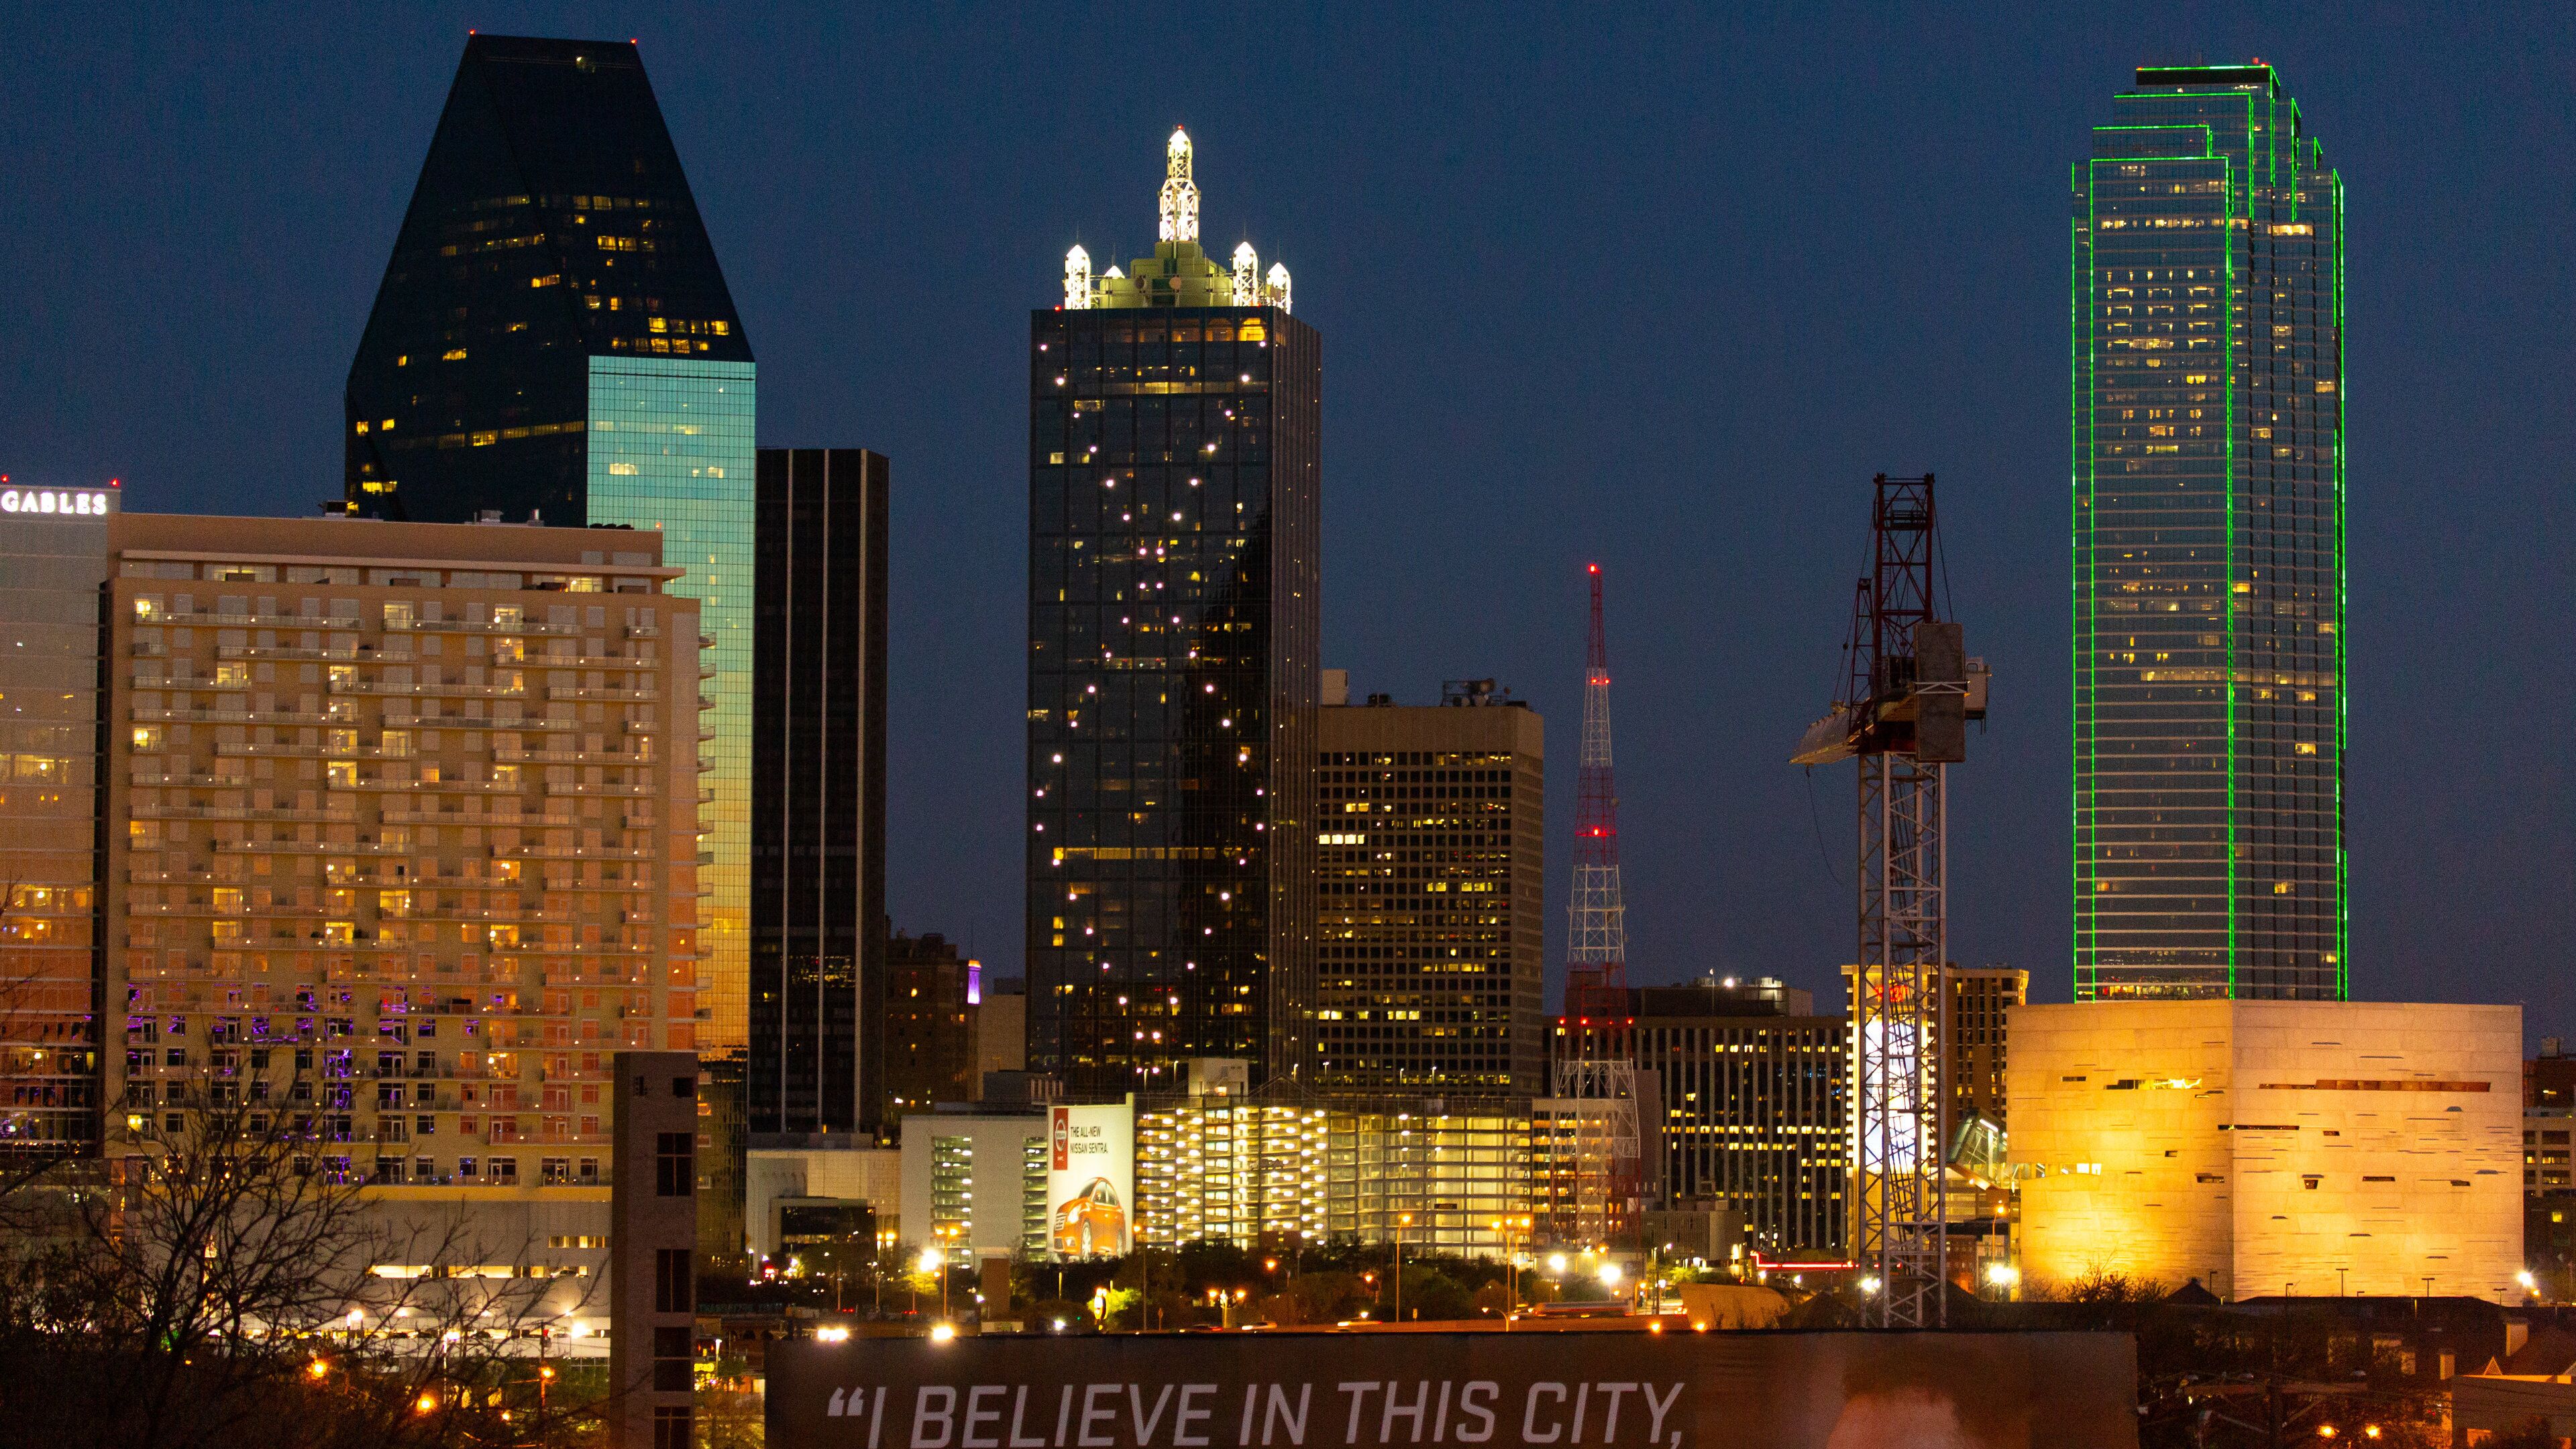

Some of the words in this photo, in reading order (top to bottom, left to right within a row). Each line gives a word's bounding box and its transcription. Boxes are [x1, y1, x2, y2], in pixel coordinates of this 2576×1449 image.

[1, 490, 107, 515] GABLES
[1070, 1126, 1079, 1137] THE
[1080, 1126, 1101, 1138] ALL-NEW
[1070, 1142, 1087, 1154] NISSAN
[1089, 1142, 1109, 1154] SENTRA.
[910, 1384, 1218, 1449] BELIEVE
[1238, 1383, 1312, 1446] IN
[1337, 1381, 1500, 1444] THIS
[1521, 1382, 1684, 1449] CITY,
